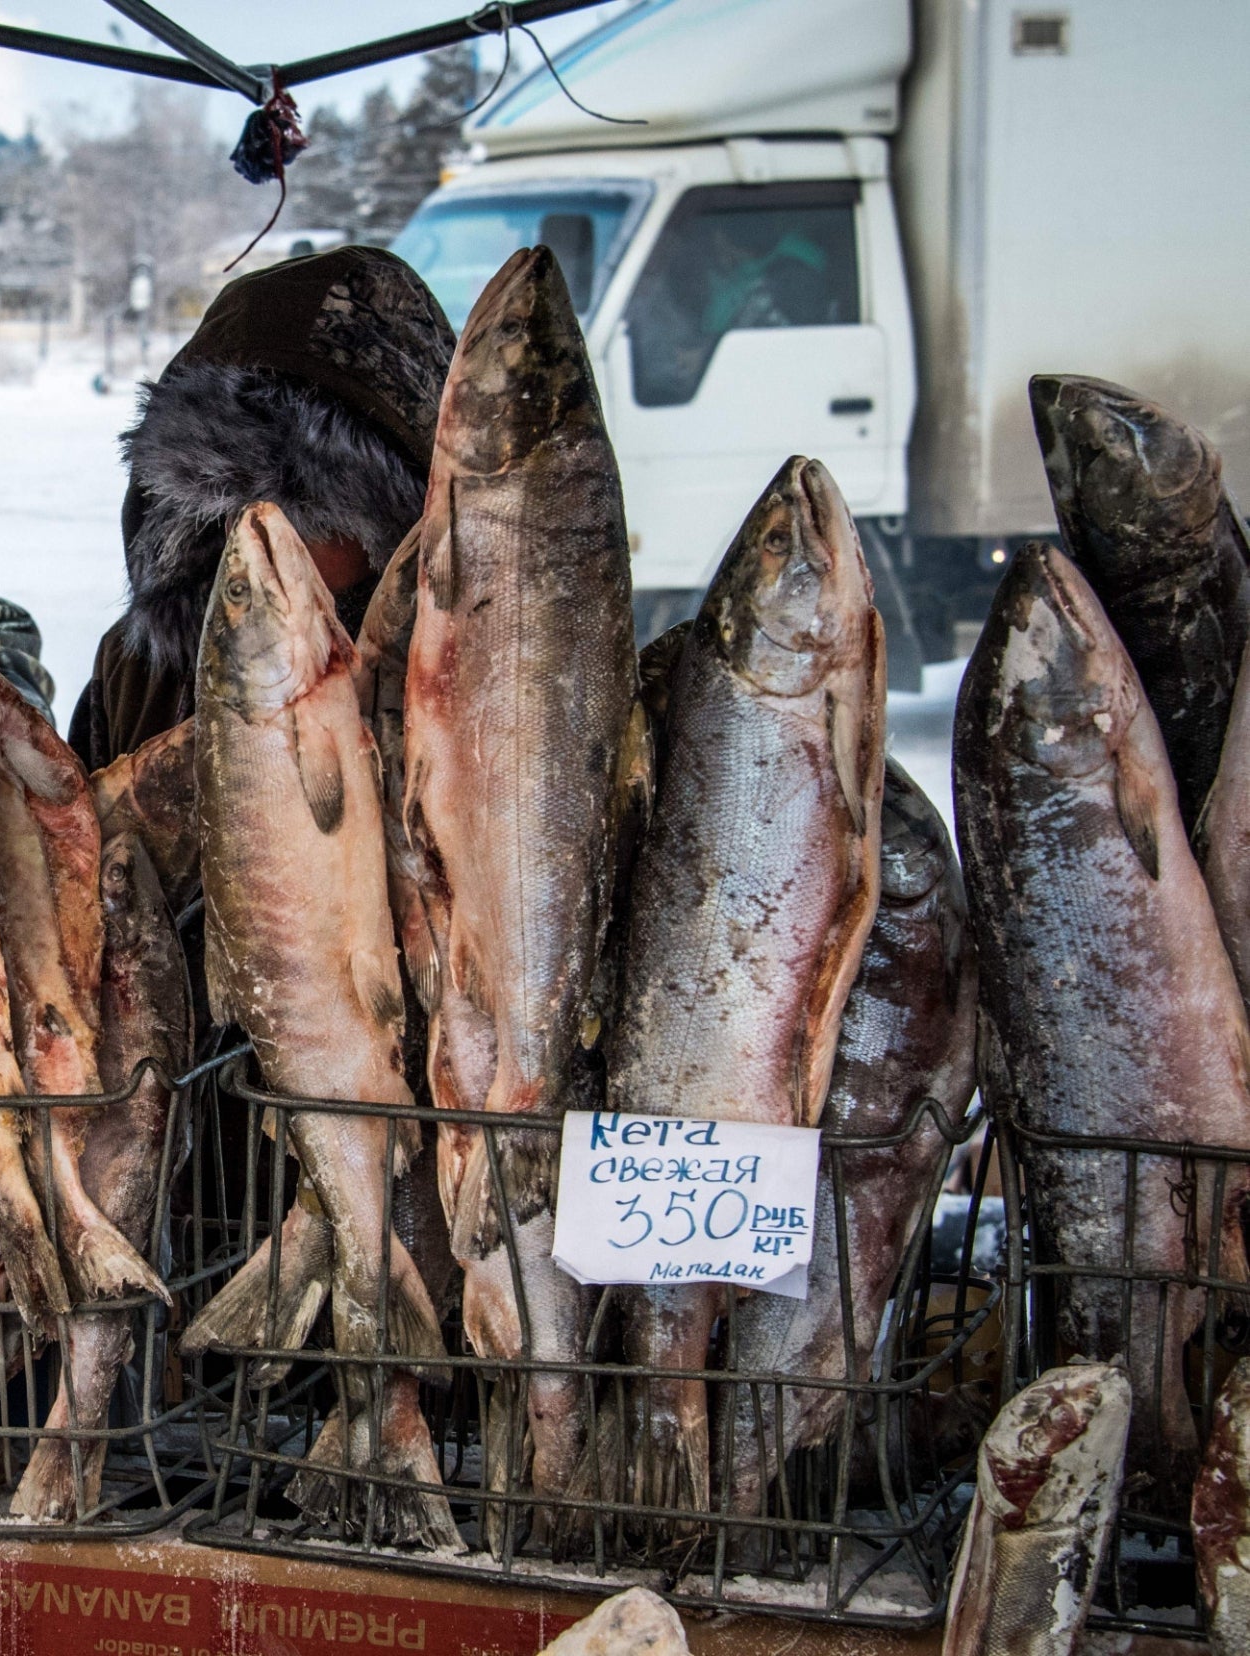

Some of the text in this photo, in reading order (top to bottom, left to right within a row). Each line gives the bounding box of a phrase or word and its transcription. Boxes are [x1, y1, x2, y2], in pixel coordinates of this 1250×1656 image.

[588, 1112, 720, 1150] Кета
[590, 1155, 761, 1184] свежая
[607, 1189, 749, 1249] 350
[649, 1260, 766, 1281] Магадан
[221, 1600, 426, 1650] PREMIUM
